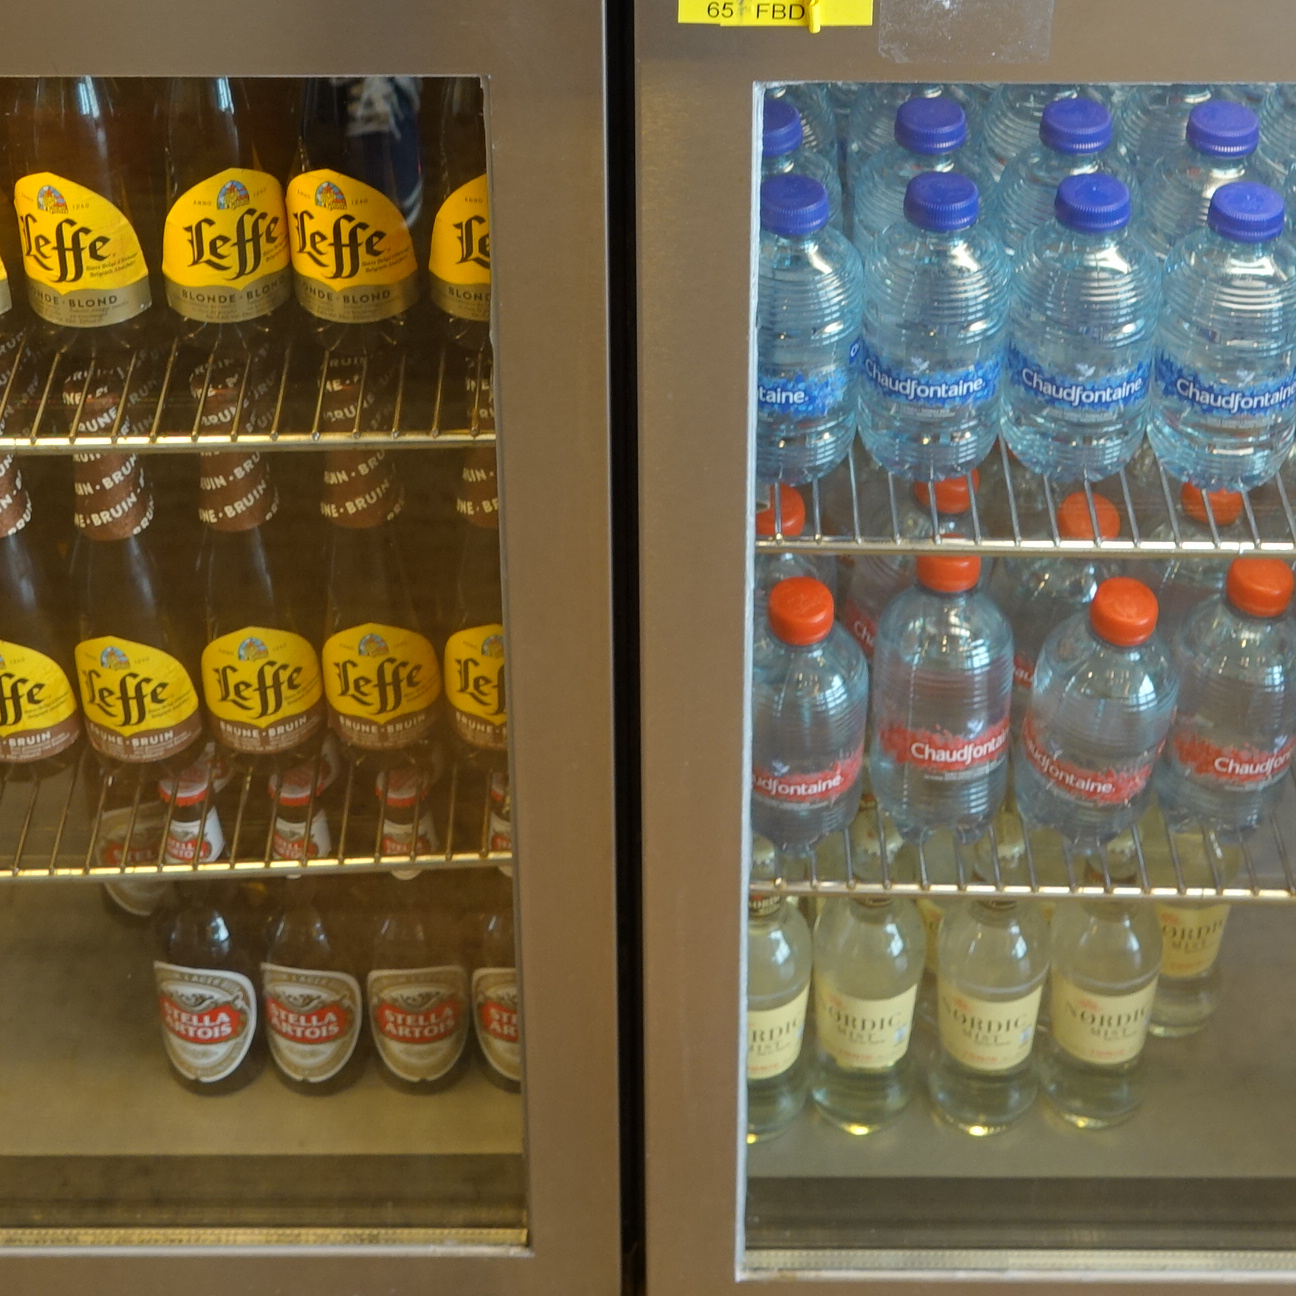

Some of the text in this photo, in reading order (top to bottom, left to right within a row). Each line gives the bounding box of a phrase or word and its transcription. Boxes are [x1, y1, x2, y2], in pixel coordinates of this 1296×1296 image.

[707, 2, 805, 20] 65 FBD
[188, 208, 280, 280] Leffe
[292, 208, 385, 279] Leffe
[68, 294, 118, 307] BLOND
[182, 288, 234, 305] BLONDE
[343, 288, 391, 303] BLOND
[865, 358, 983, 400] Chaudfontaine
[1021, 367, 1143, 405] Chaudfontaine
[92, 493, 138, 527] BRUIN
[86, 669, 169, 726] Leffe
[213, 660, 304, 718] Leffe
[335, 657, 423, 714] Leffe
[220, 716, 307, 738] BRUNE BRUIN
[339, 713, 426, 734] BRUNE BRUIN
[8, 731, 51, 747] BRUIN
[132, 730, 174, 748] BRUIN
[752, 772, 841, 796] udfontaine
